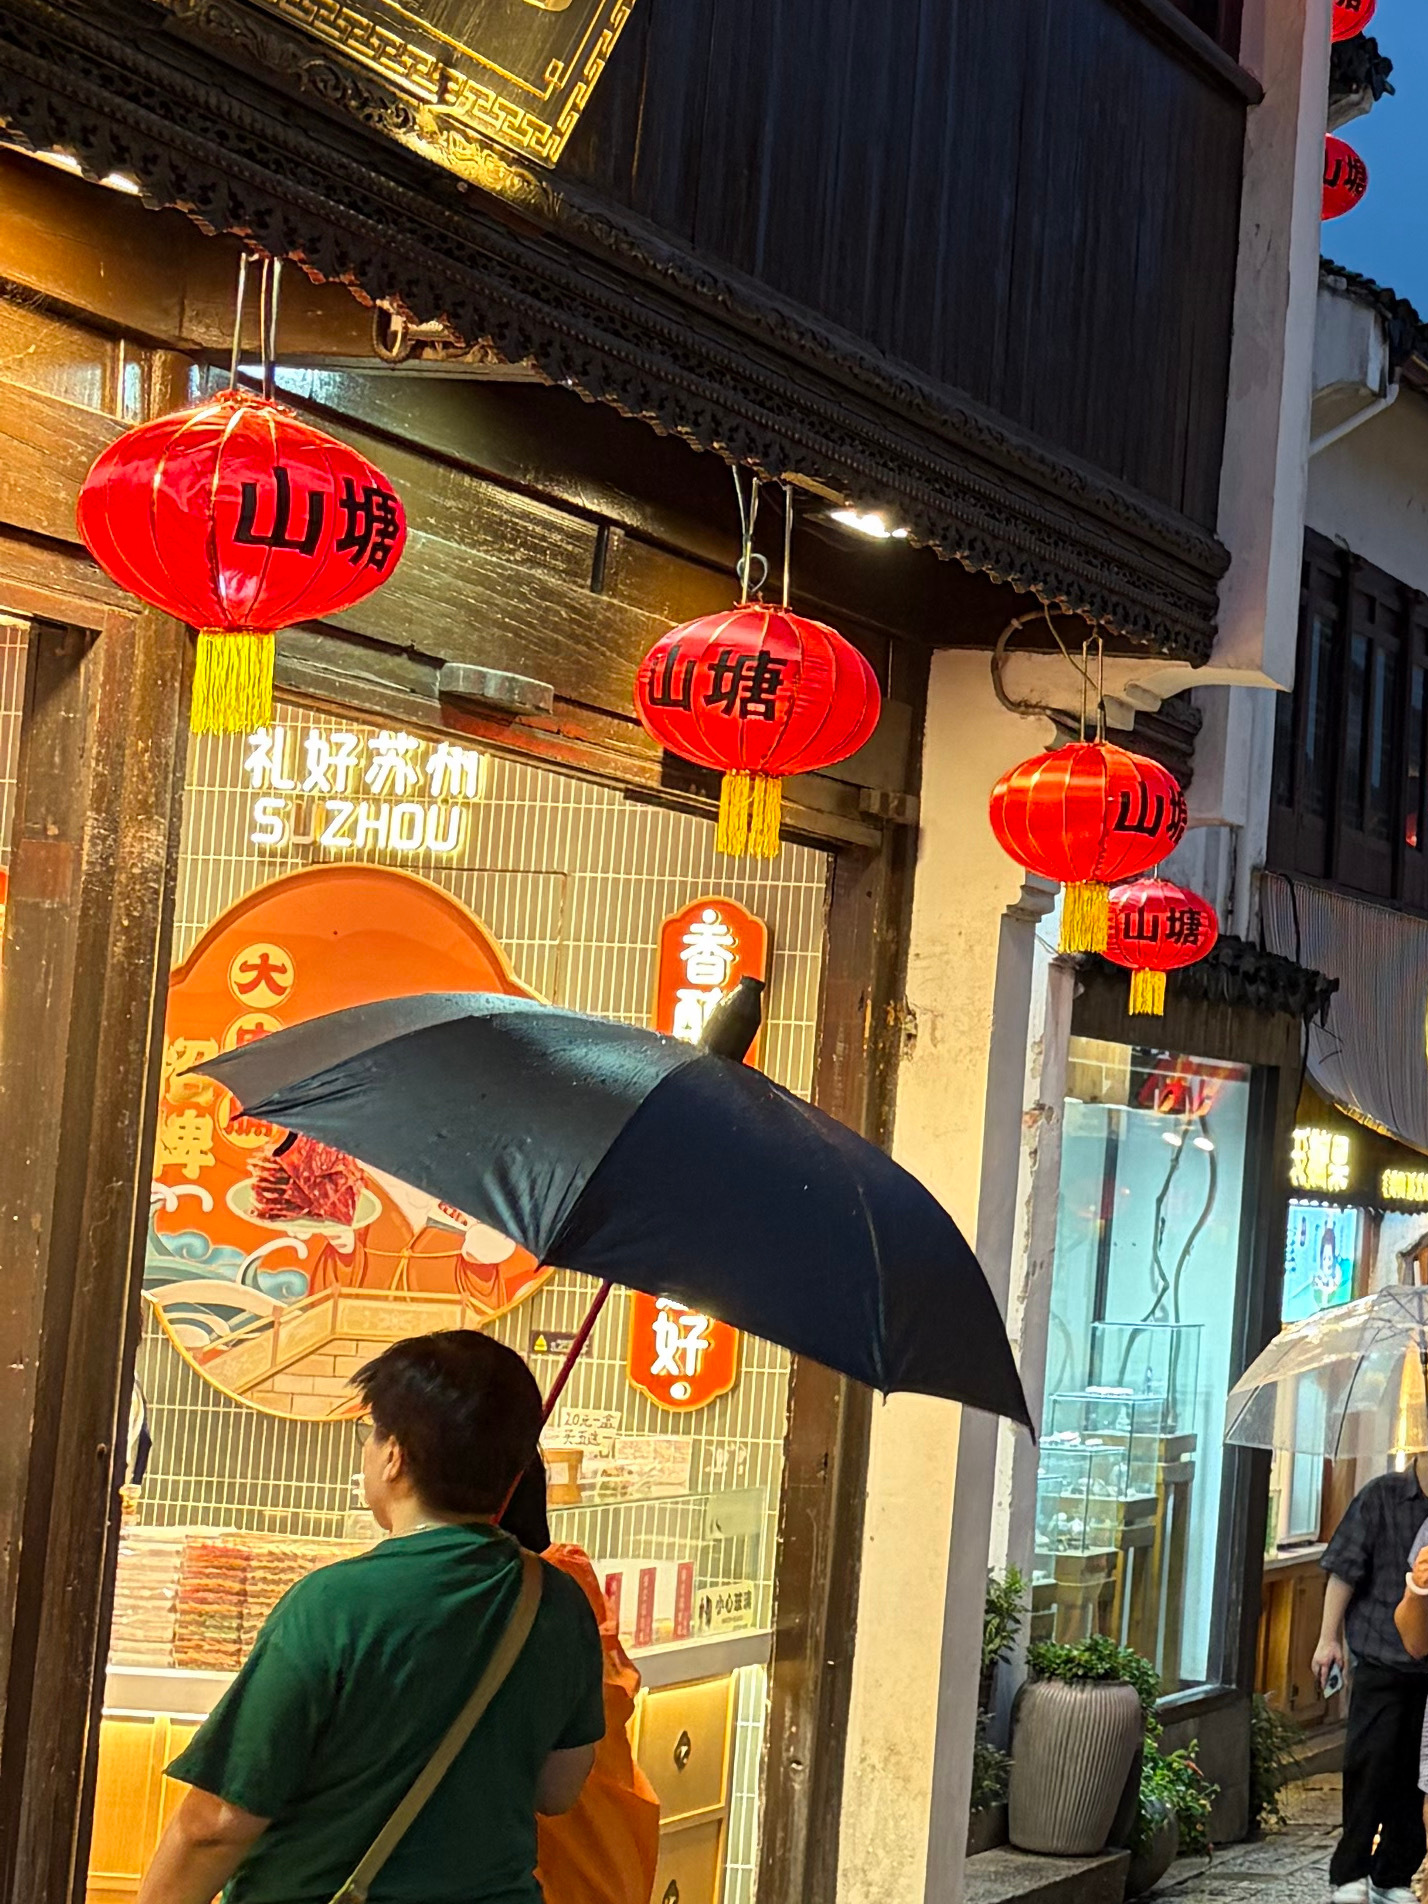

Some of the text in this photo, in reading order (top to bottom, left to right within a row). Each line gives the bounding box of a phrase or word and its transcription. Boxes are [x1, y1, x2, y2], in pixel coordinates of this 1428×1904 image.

[233, 466, 400, 573] 山塘
[648, 644, 788, 722] 山塘
[244, 725, 479, 799] 礼好苏州
[1124, 906, 1202, 946] 山塘
